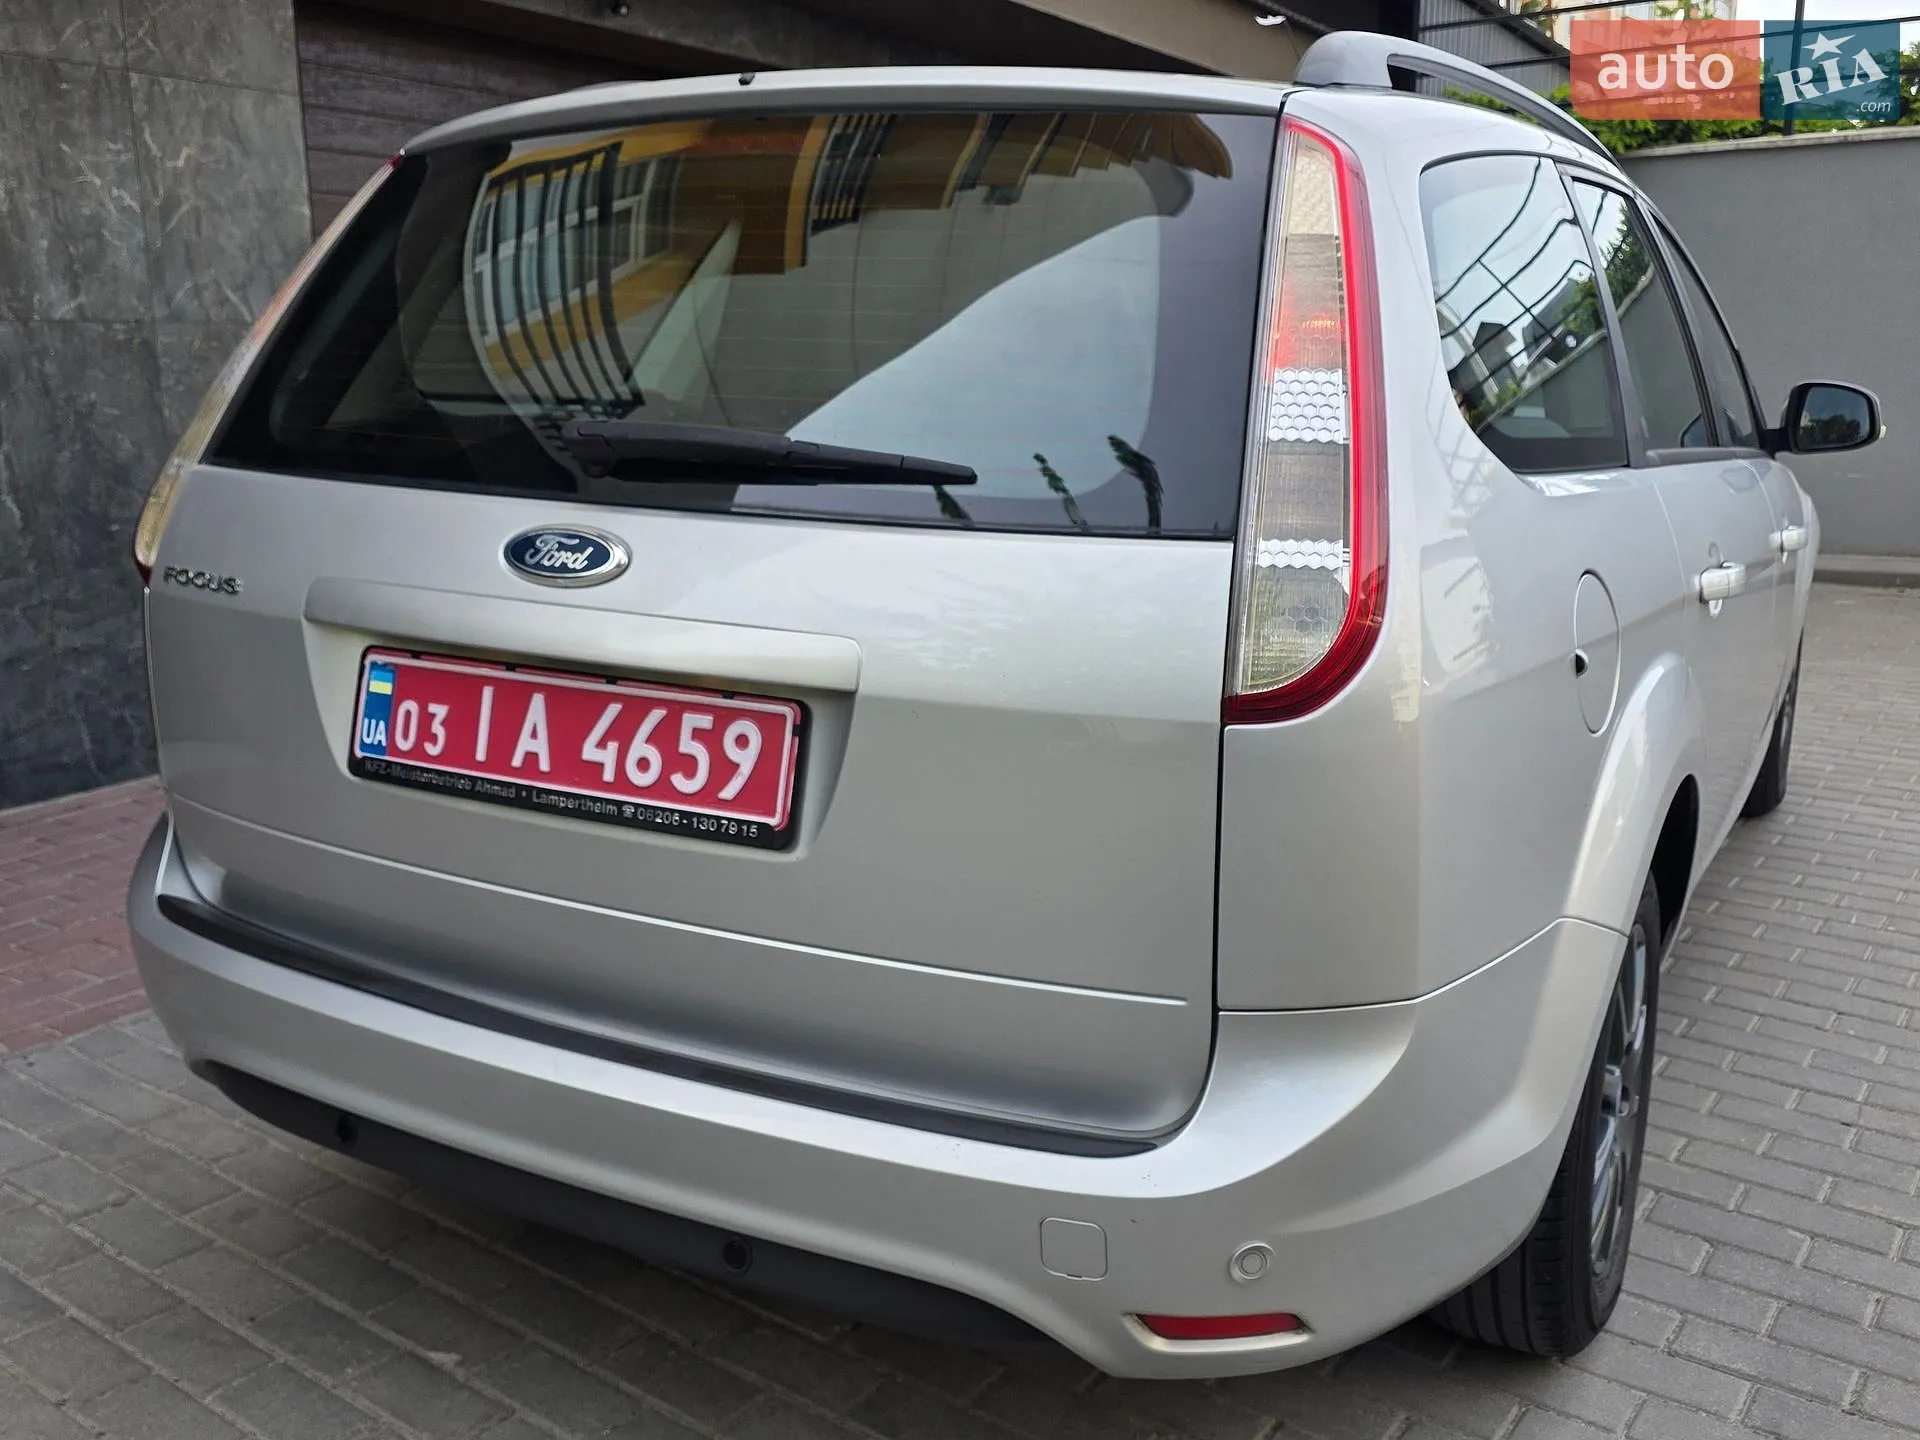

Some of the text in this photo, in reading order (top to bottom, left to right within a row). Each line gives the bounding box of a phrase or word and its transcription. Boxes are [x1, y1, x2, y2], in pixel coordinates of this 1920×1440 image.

[524, 534, 594, 570] Ford
[163, 566, 243, 596] FOCUS
[362, 717, 387, 747] UA
[394, 699, 449, 757] 03
[580, 702, 763, 801] 4659
[474, 778, 517, 799] Ahmad
[532, 789, 619, 817] Lampertheim
